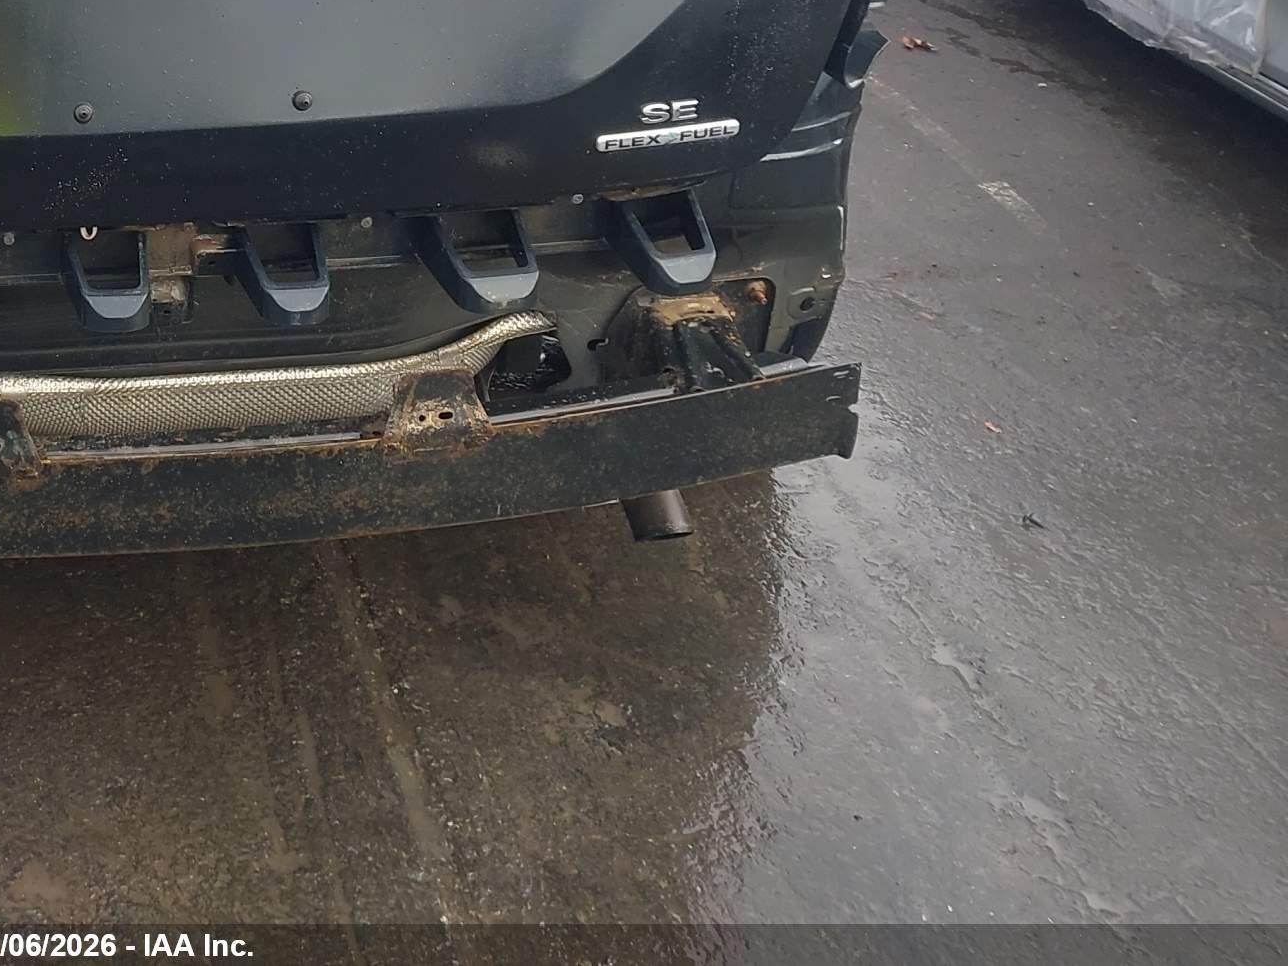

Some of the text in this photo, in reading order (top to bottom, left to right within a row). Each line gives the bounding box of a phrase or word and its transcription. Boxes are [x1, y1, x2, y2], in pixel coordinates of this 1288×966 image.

[640, 99, 699, 124] SE
[604, 125, 738, 150] FLEX FUEL
